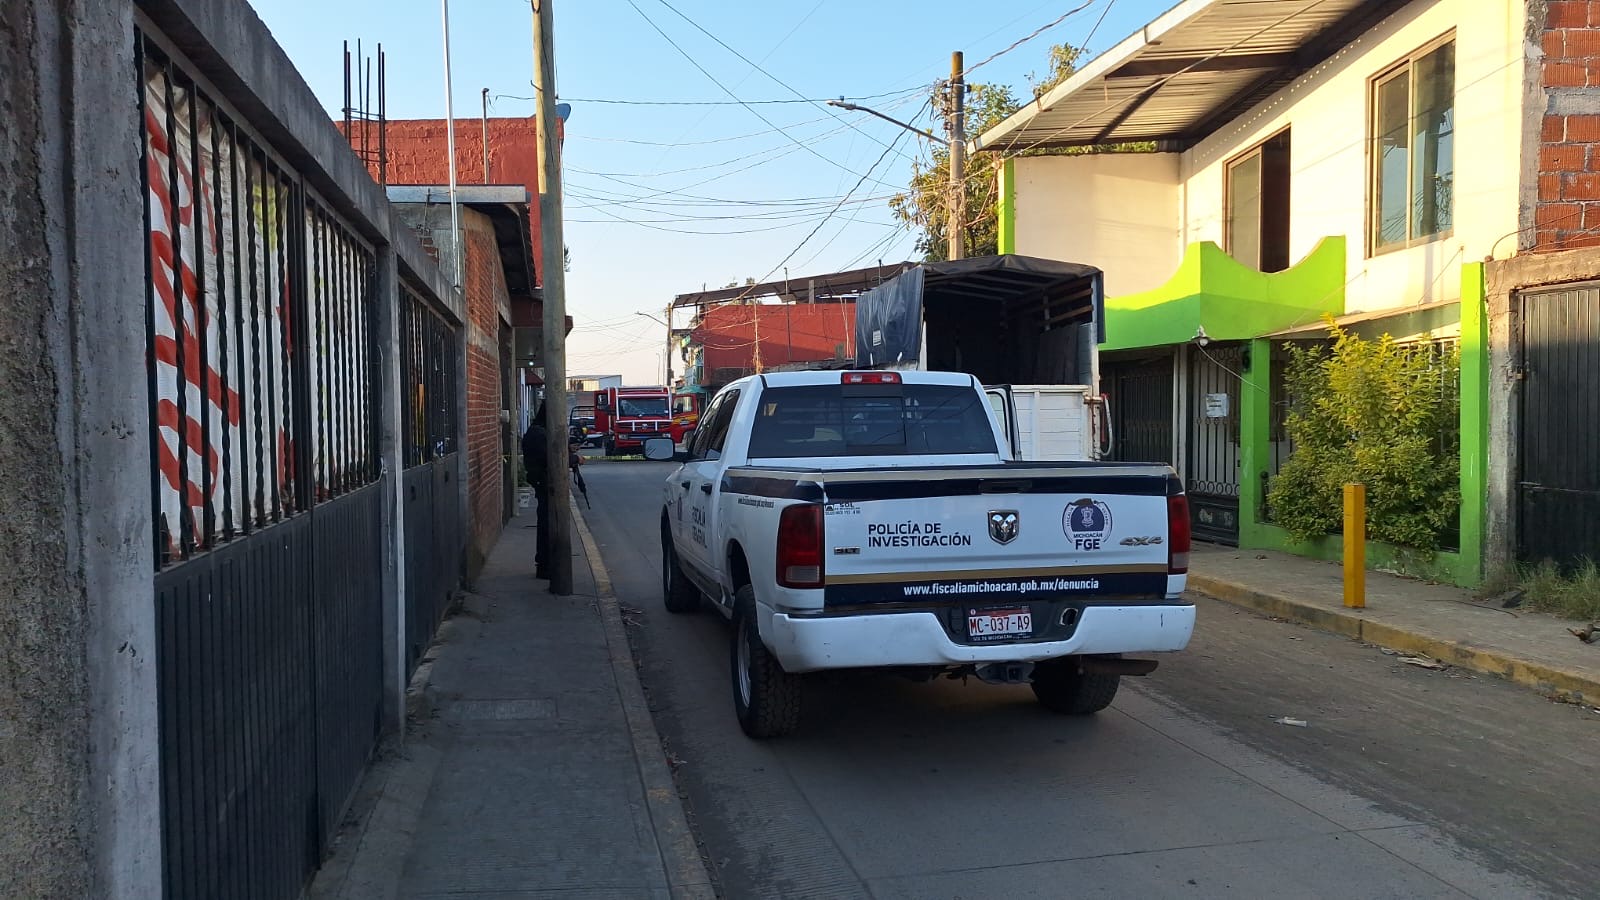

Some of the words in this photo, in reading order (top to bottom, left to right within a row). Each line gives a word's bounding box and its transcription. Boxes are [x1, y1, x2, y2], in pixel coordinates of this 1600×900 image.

[868, 520, 921, 535] POLICÍA
[924, 523, 942, 534] DE
[868, 532, 971, 547] INVESTIGACIÓN
[1075, 538, 1101, 551] FGE
[904, 578, 1099, 596] www.fiscaliamichoacan.gob.mx/denuncia
[970, 615, 1030, 634] MC-037-A9
